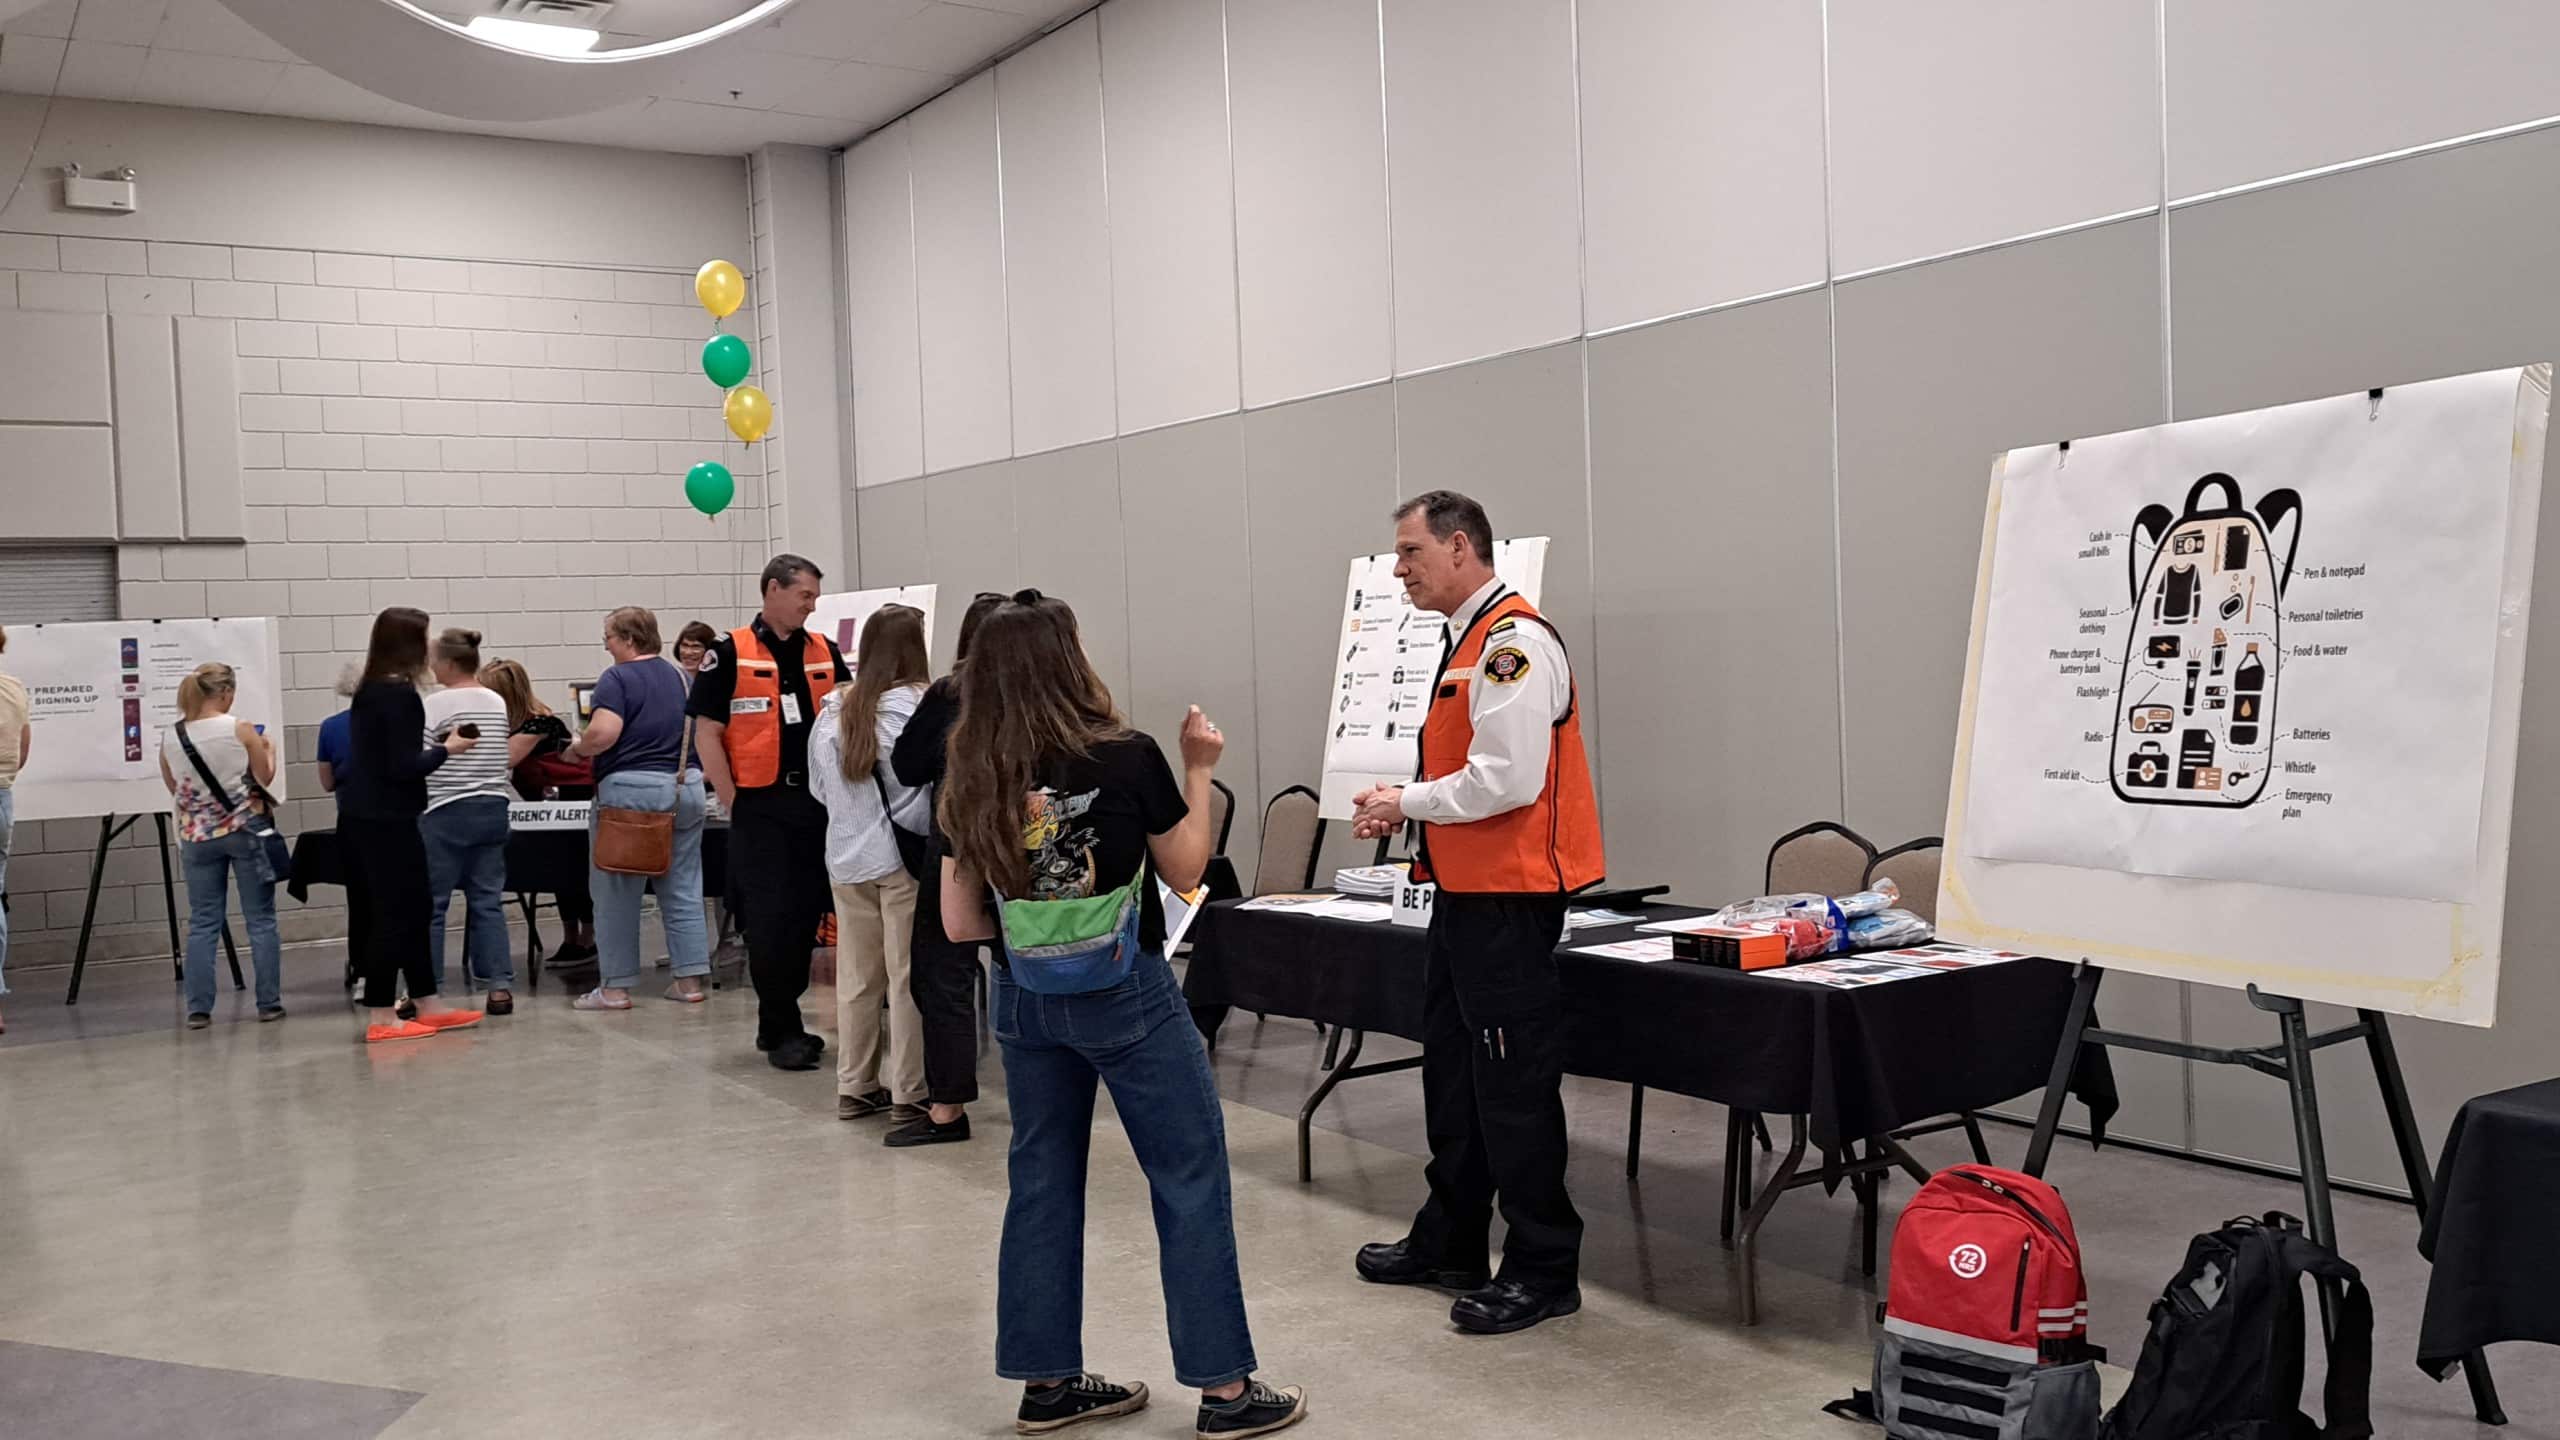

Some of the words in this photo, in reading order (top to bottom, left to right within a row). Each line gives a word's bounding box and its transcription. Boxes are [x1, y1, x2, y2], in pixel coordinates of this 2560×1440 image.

[2089, 531, 2104, 542] Cash
[2304, 568, 2319, 579] Pen
[2320, 566, 2327, 578] &
[2329, 563, 2366, 579] notepad
[2080, 606, 2107, 618] Seasonal
[2288, 609, 2323, 623] Personal
[2325, 608, 2363, 620] toiletries
[2080, 622, 2106, 635] clothing
[2049, 649, 2070, 659] Phone
[2070, 648, 2095, 661] charger
[2293, 644, 2313, 656] Food
[2314, 644, 2321, 656] &
[2322, 645, 2348, 656] water
[2060, 663, 2083, 676] battery
[2084, 662, 2101, 674] bank
[34, 685, 94, 695] PREPARED
[2076, 686, 2109, 700] Flashlight
[34, 695, 81, 705] SIGNING
[84, 695, 99, 703] UP
[2084, 731, 2103, 742] Radio
[2293, 728, 2330, 740] Batteries
[2285, 761, 2317, 774] Whistle
[2044, 769, 2058, 779] First
[2059, 769, 2070, 780] aid
[2285, 788, 2333, 805] Emergency
[2282, 806, 2302, 820] plan
[1403, 888, 1419, 910] BE
